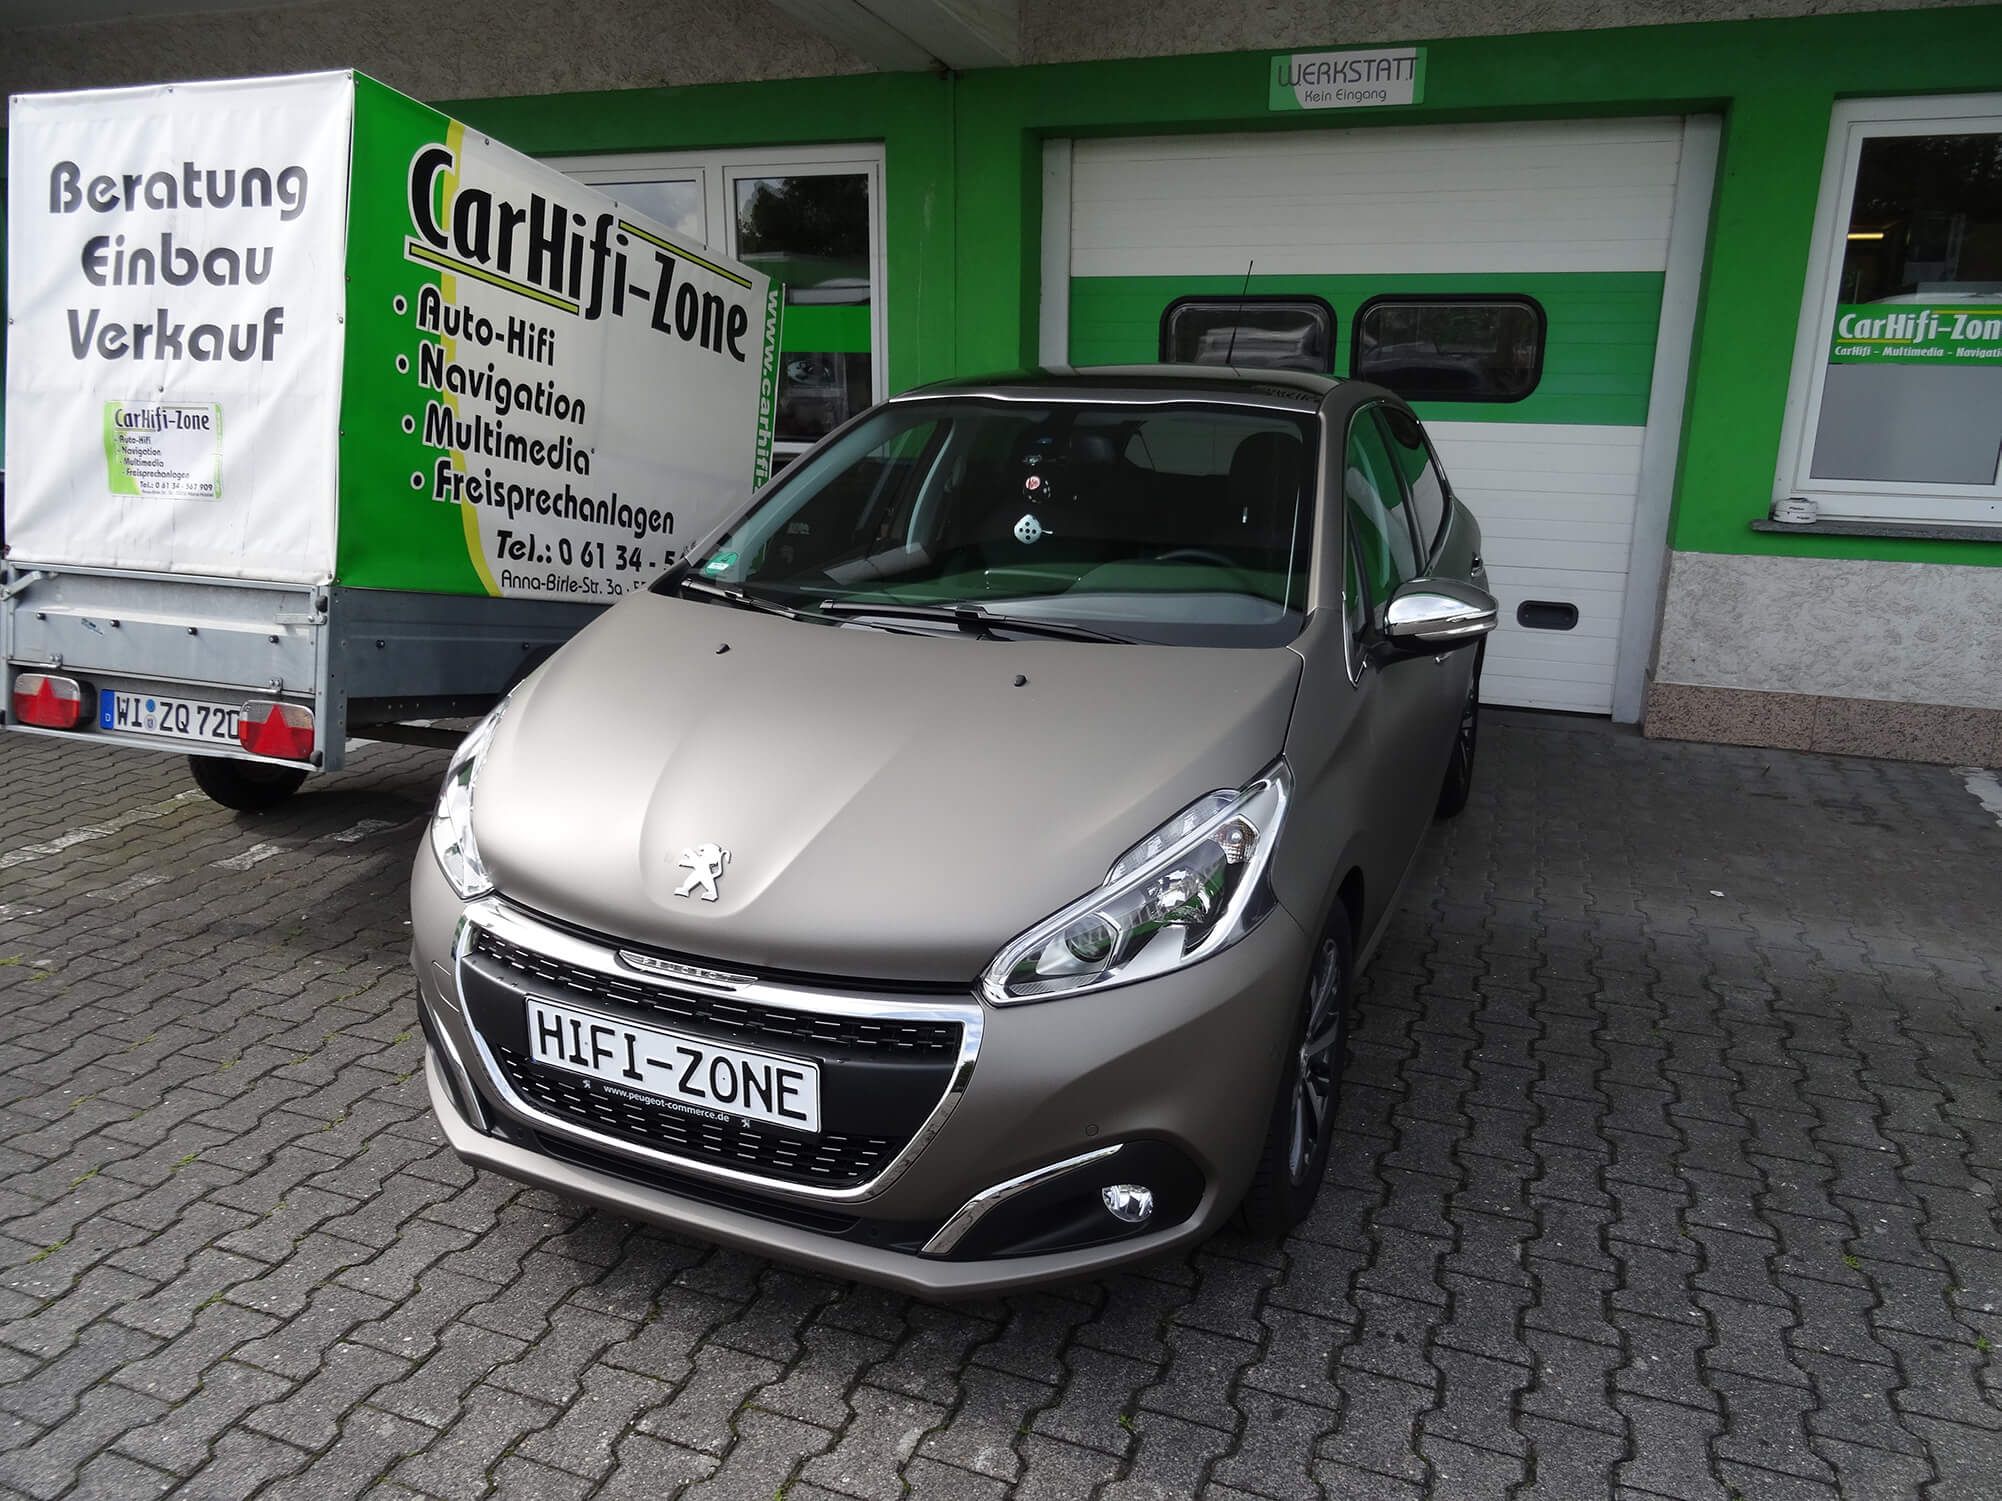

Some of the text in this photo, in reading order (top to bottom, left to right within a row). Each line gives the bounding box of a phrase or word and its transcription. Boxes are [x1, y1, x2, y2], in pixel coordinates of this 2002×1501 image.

[1278, 57, 1419, 87] WERKSTATT
[1305, 88, 1387, 103] Kein Eingang
[49, 160, 308, 221] Beratung
[81, 232, 274, 286] Einbau
[409, 147, 749, 363] CarHifi-Zone
[67, 306, 285, 362] Verkauf
[418, 286, 555, 367] Auto-Hifi
[1882, 346, 1945, 357] Multimedia
[420, 342, 586, 425] Navigation
[754, 290, 778, 492] www.carhifi-
[115, 407, 210, 432] CarHifi-Zone
[424, 402, 591, 476] Multimedia
[121, 446, 161, 457] Navigation
[123, 457, 165, 468] Multimedia
[126, 468, 190, 480] Freisprechanlagen
[434, 459, 675, 540] Freisprechanlagen
[497, 529, 553, 564] Tel.:
[558, 537, 573, 566] 0
[580, 541, 605, 569] 61
[615, 544, 642, 573] 34
[664, 550, 685, 571] 5
[501, 568, 603, 595] Anna-Birle-Str.
[607, 578, 624, 596] 3a
[116, 696, 143, 728] WI
[159, 701, 190, 734] ZQ
[537, 1009, 808, 1122] HIFI-ZONE
[603, 1084, 730, 1123] www.peugeot-commerce.de
